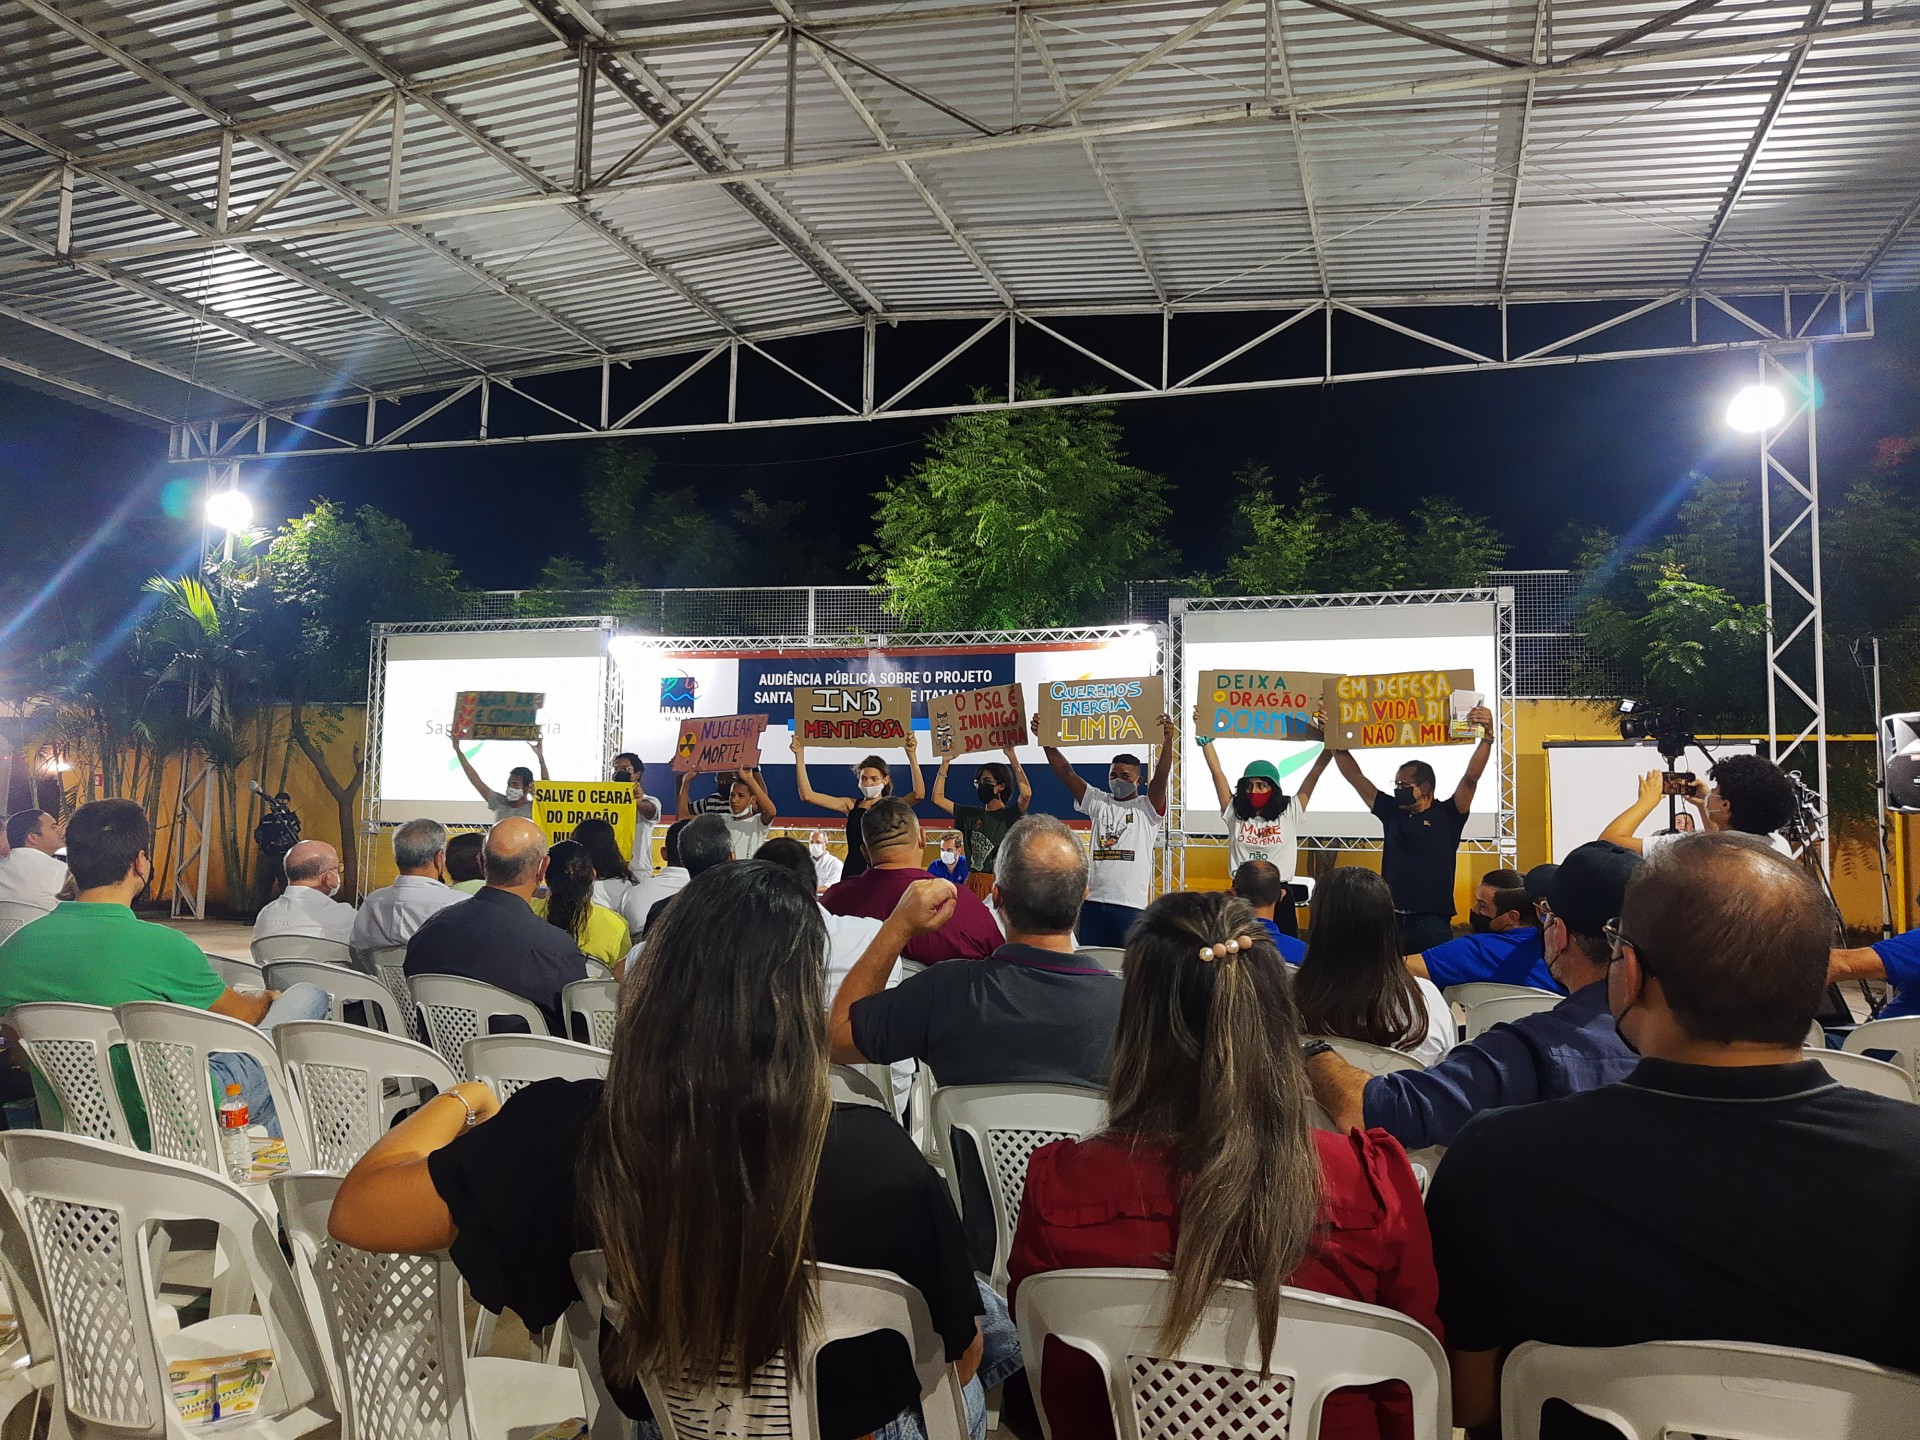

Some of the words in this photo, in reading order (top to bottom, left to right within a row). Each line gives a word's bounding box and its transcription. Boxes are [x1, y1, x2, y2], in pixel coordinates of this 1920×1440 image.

[759, 670, 822, 685] AUDIÊNCIA
[825, 670, 876, 685] PÚBLICA
[880, 671, 920, 684] SOBRE
[923, 671, 932, 684] O
[935, 669, 992, 684] PROJETO
[1217, 674, 1287, 690] DEIXA
[1336, 675, 1369, 699] EM
[1372, 671, 1451, 699] DEFESA
[754, 691, 793, 704] SANTA
[812, 688, 882, 716] INB
[954, 693, 966, 712] O
[974, 691, 1004, 711] PSQ
[1008, 685, 1018, 707] É
[1061, 698, 1131, 717] ENERGIA
[1229, 691, 1307, 708] DRAGÃO
[660, 706, 692, 714] IBAMA
[958, 709, 1019, 730] INIMIGO
[1339, 700, 1369, 723] DA
[700, 718, 754, 741] NUCLEAR
[804, 718, 905, 739] MENTIROSA
[1061, 715, 1143, 741] LIMPA
[1213, 707, 1310, 735] DORMIR
[964, 733, 982, 752] DO
[988, 727, 1028, 747] CLIMA
[1361, 721, 1396, 747] NÃO
[697, 740, 745, 765] MORTE!
[536, 788, 574, 803] SALVE
[577, 789, 586, 803] O
[590, 788, 632, 804] CEARÁ
[547, 810, 563, 823] DO
[1246, 835, 1282, 845] SISTEMA
[1249, 850, 1268, 860] não
